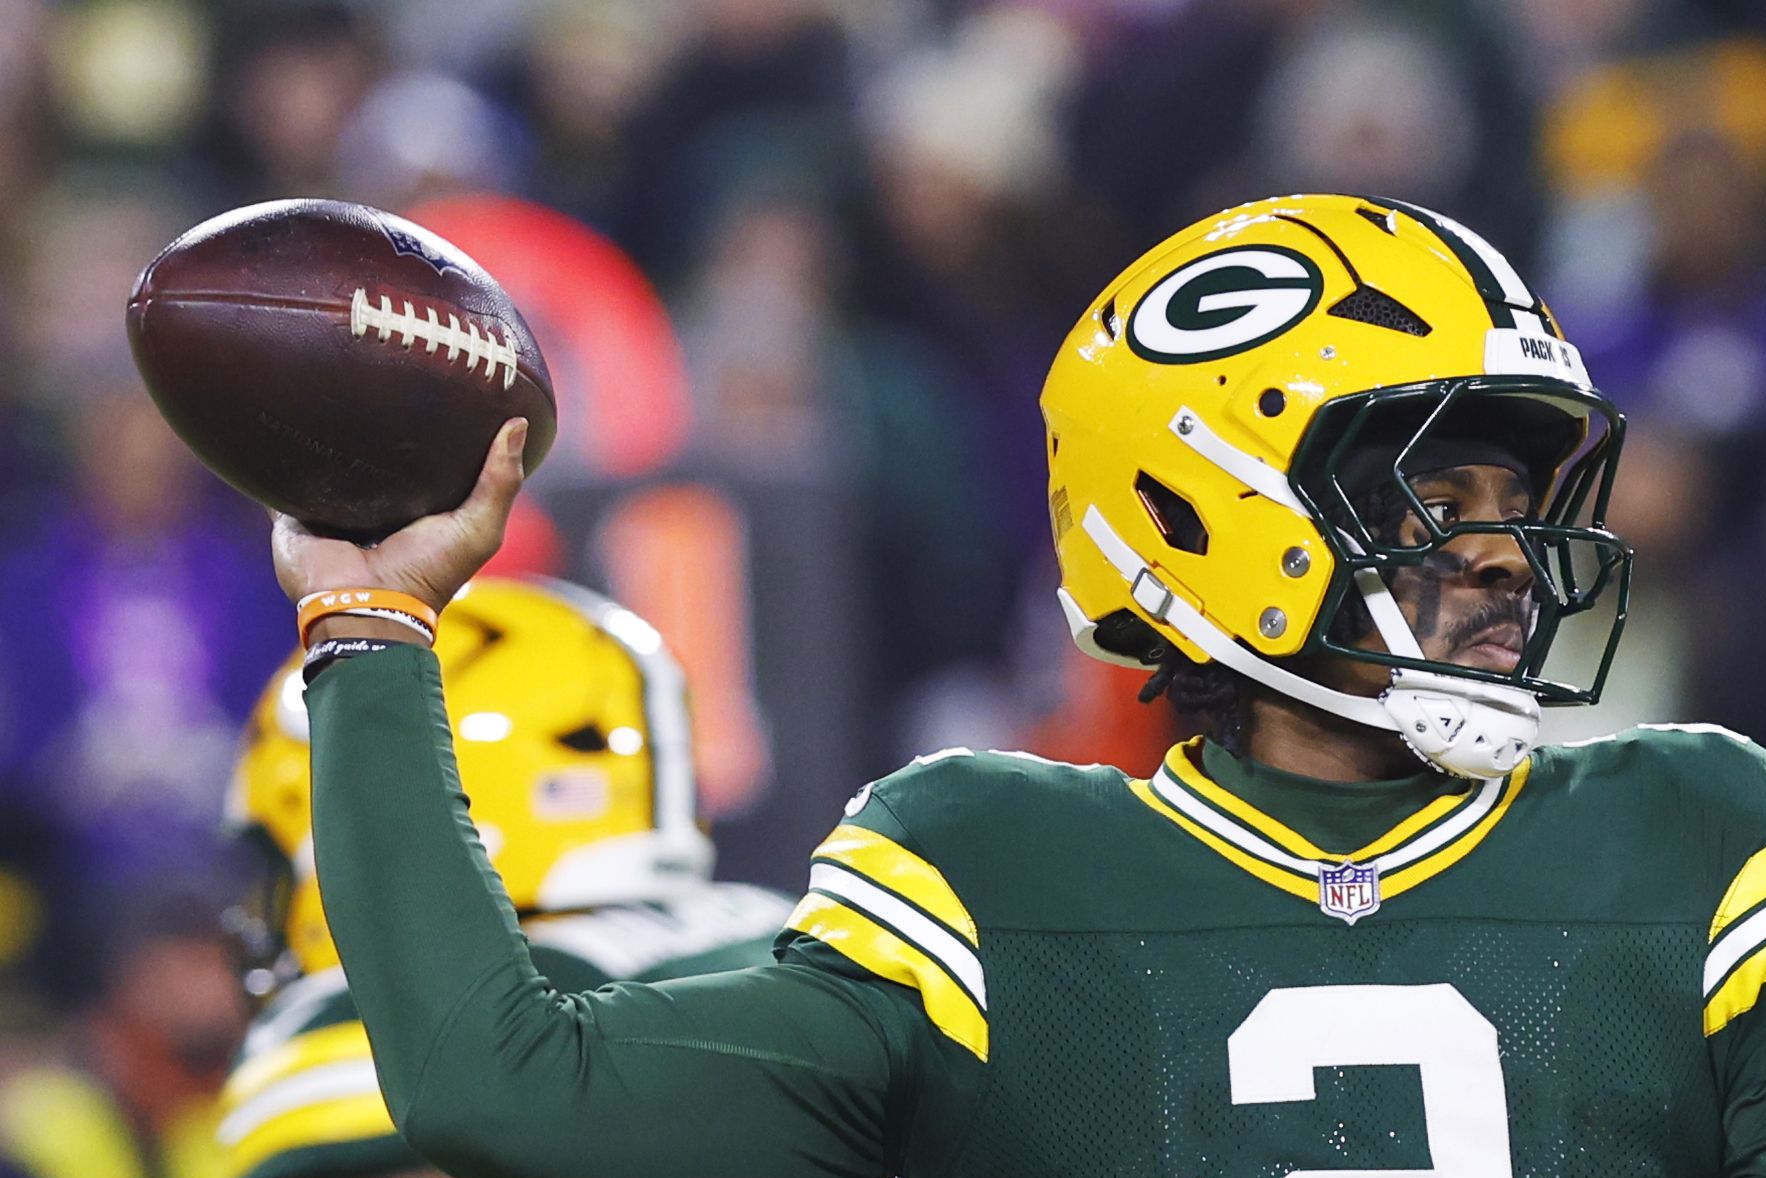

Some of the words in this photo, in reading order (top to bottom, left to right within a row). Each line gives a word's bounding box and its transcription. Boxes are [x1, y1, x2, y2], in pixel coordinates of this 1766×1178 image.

[1134, 250, 1312, 355] G
[334, 640, 370, 655] guide
[1329, 884, 1371, 910] NFL
